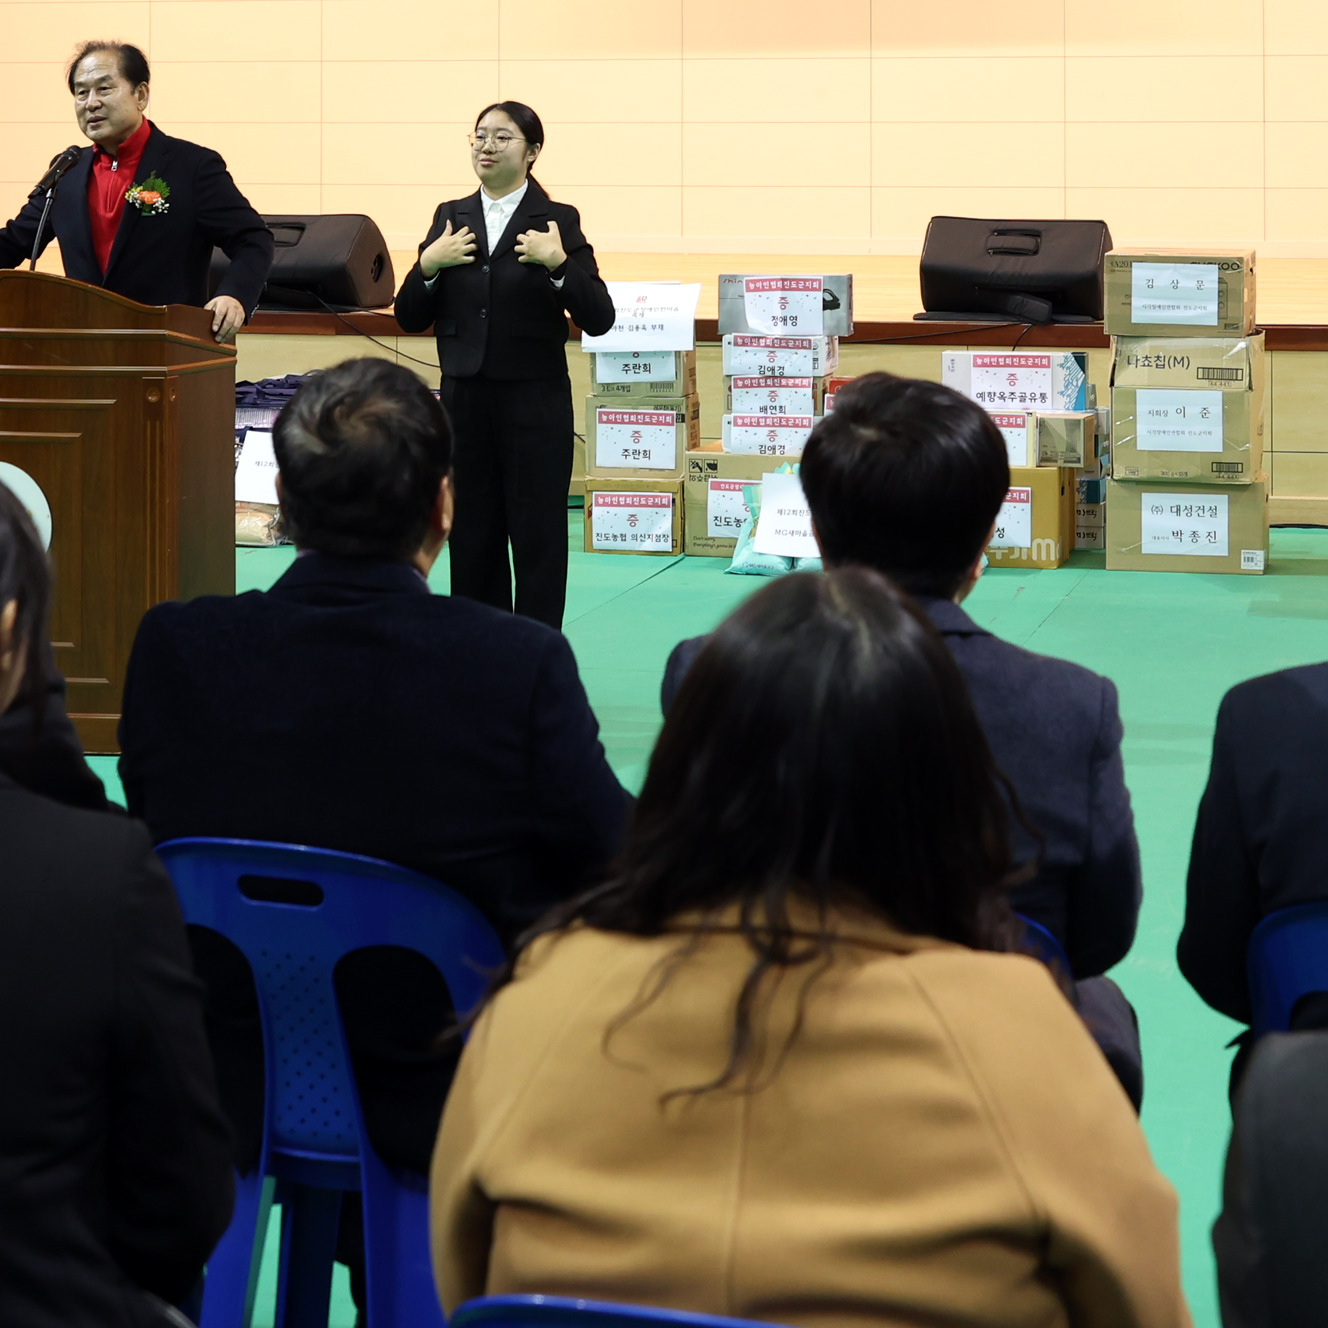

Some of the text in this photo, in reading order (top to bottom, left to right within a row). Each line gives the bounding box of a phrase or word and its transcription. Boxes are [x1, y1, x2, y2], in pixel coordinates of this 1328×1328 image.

[749, 280, 819, 290] 농아인협회진도군지회
[778, 296, 789, 310] 증
[737, 337, 810, 348] 농아인협회진도군지회
[766, 351, 778, 363] 증
[976, 357, 1048, 366] 농아인협회진도군지회
[1127, 354, 1190, 370] 나쵸칩(M)
[737, 378, 810, 387] 농아인협회진도군지회
[1006, 373, 1019, 387] 증
[767, 390, 779, 403] 증
[975, 391, 1048, 403] 예향옥주골유통
[601, 413, 673, 424] 농아인협회진도군지회
[737, 417, 810, 427] 농아인협회진도군지회
[630, 430, 643, 444] 증
[766, 430, 778, 442] 증
[597, 496, 669, 506] 농아인협회진도군지회
[1170, 504, 1218, 518] 대성건설
[626, 514, 640, 528] 증
[595, 533, 626, 542] 진도농협
